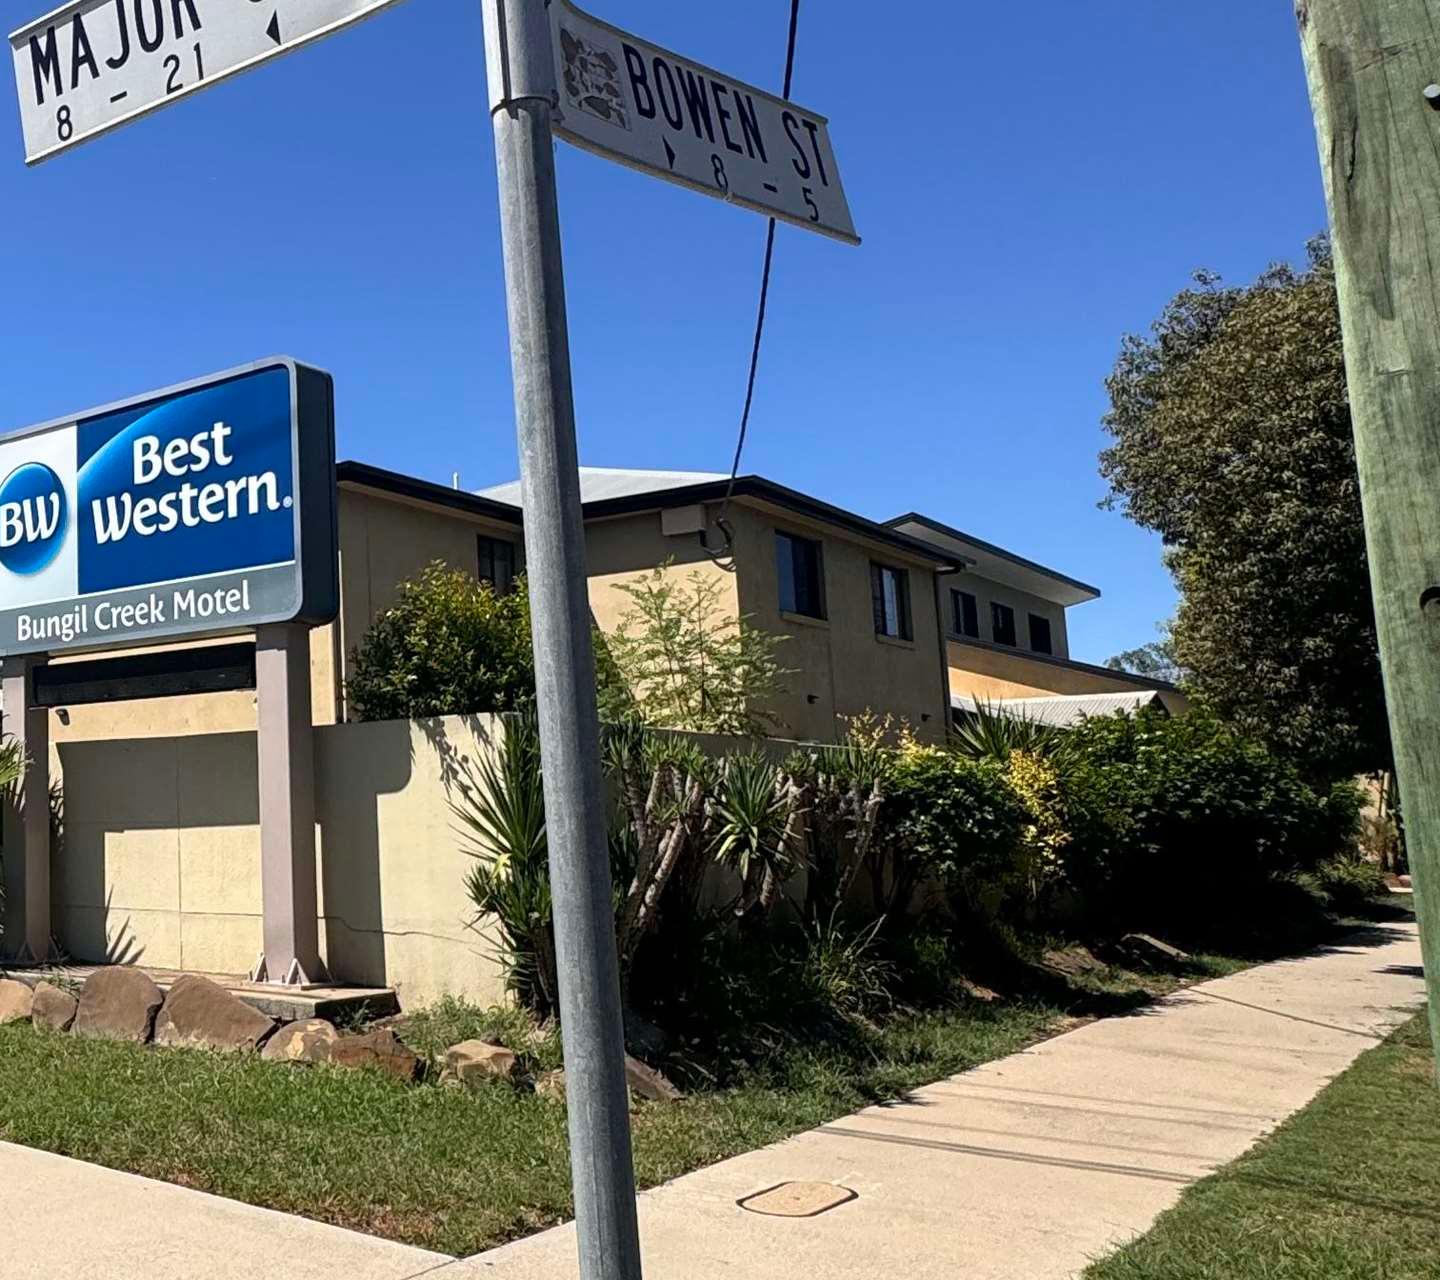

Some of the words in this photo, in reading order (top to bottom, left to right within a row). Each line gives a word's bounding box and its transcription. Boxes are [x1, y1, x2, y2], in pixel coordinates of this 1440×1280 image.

[56, 105, 73, 141] 8
[162, 43, 203, 95] 21
[621, 41, 769, 165] BOWEN
[781, 111, 828, 186] ST
[802, 187, 819, 222] 5
[131, 420, 234, 485] Best
[90, 470, 281, 545] Western
[16, 605, 88, 643] Bungil
[93, 593, 166, 631] Creek
[172, 579, 251, 620] Motel
